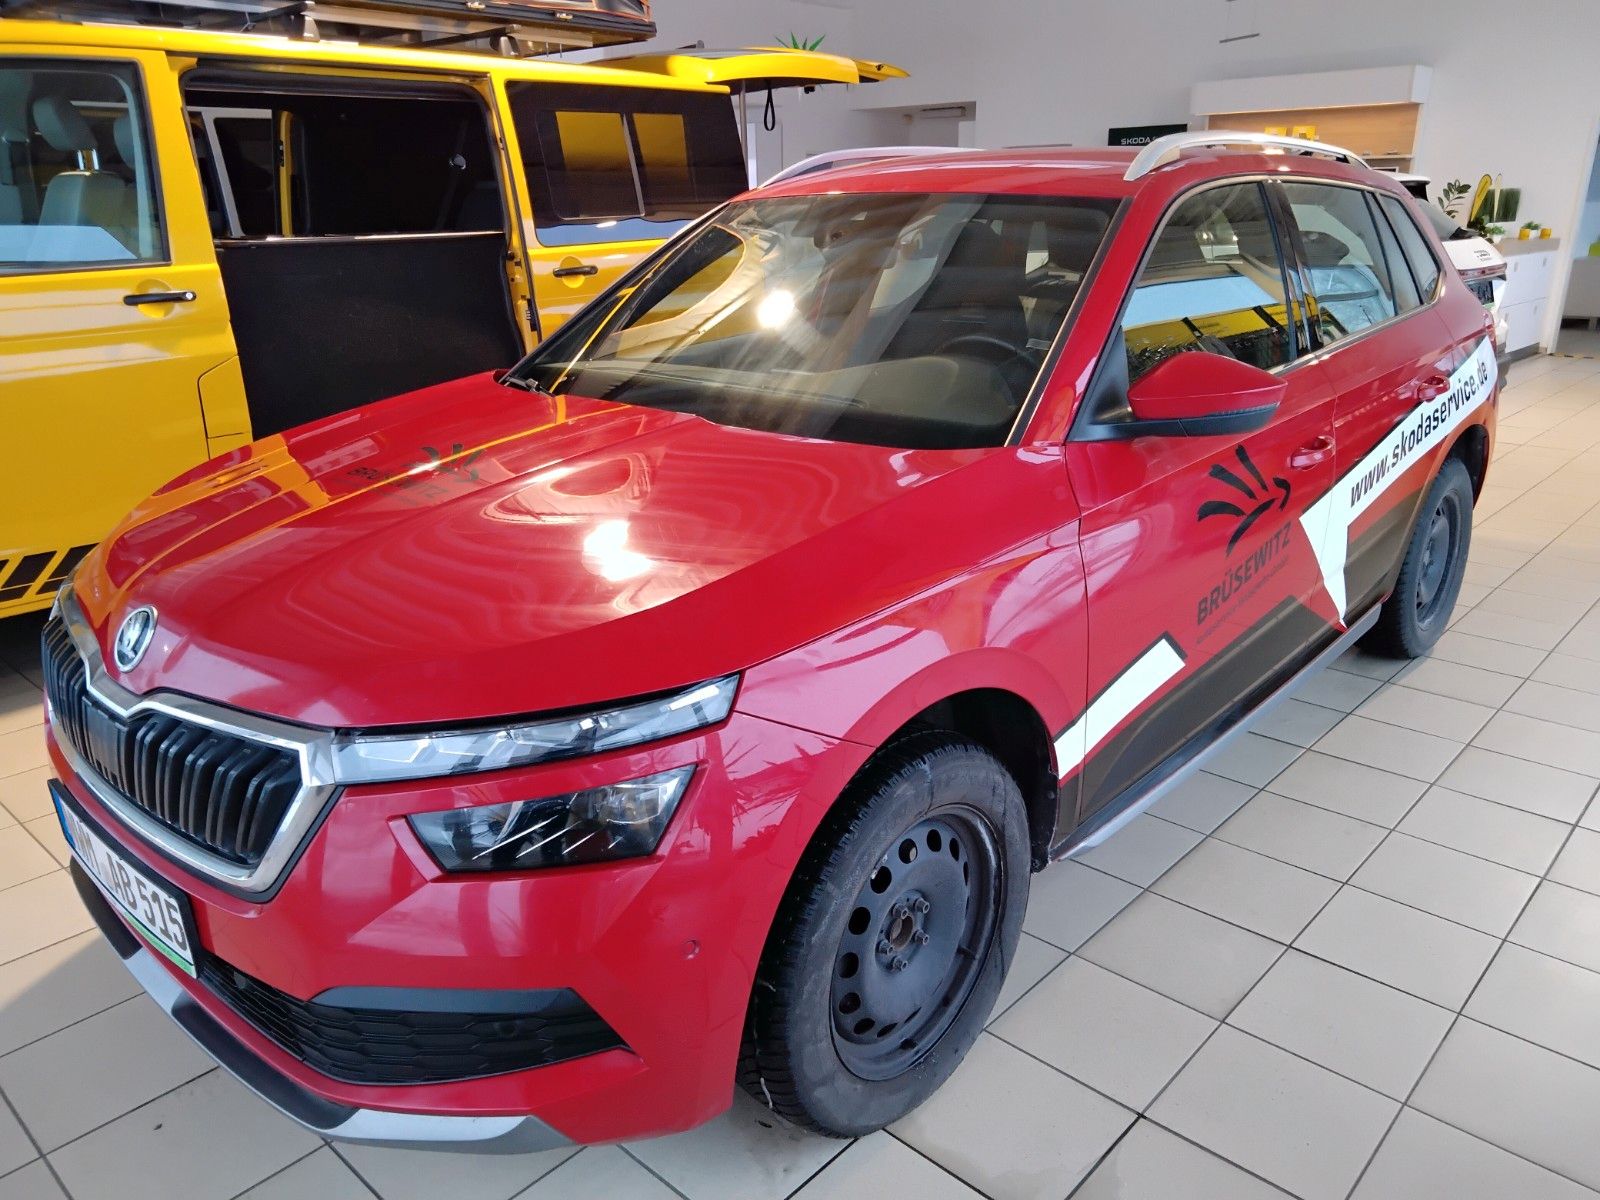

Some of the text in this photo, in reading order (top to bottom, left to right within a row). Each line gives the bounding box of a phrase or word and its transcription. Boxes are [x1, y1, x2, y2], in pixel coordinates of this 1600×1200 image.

[1349, 359, 1488, 508] www.skodaservice.de
[1197, 522, 1293, 625] BRÜSEWITZ
[106, 852, 138, 911] AB
[134, 876, 188, 951] 515
